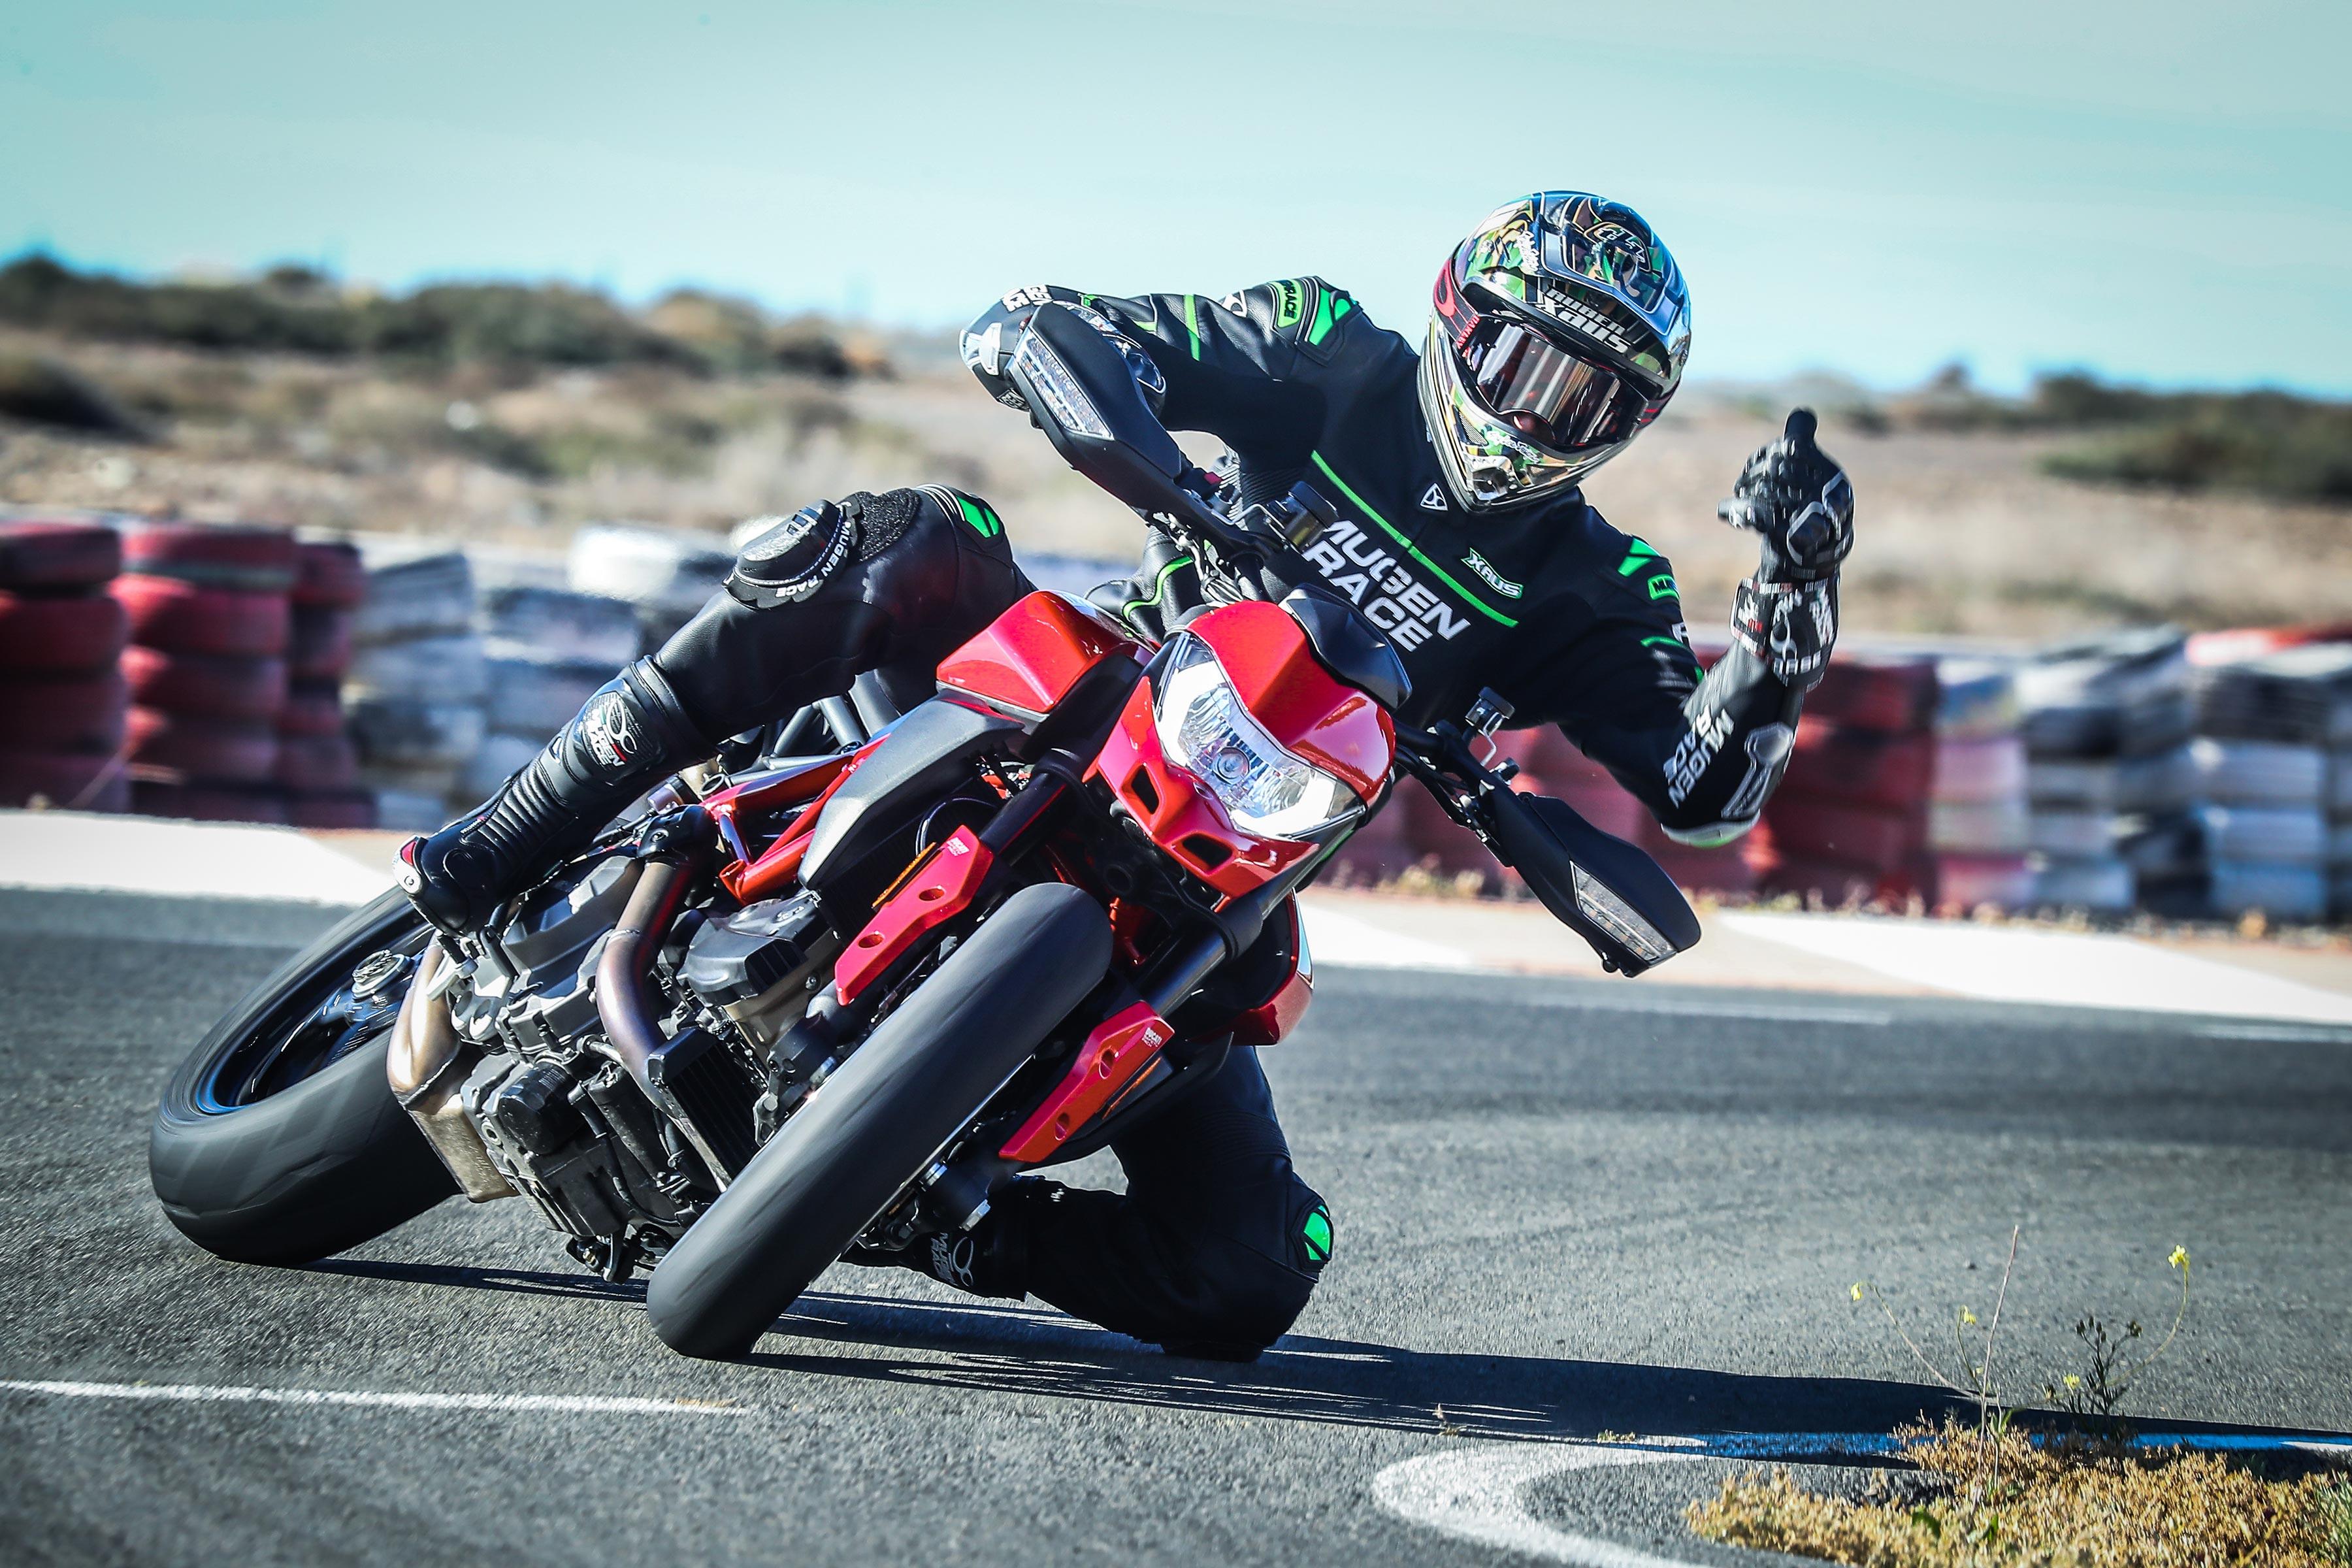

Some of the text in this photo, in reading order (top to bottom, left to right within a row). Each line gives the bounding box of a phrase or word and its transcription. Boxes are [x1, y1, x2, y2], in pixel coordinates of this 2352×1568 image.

[1456, 315, 1480, 350] OAKLEY
[821, 525, 851, 578] MUGEN
[1323, 520, 1471, 640] MUGEN
[1465, 552, 1522, 597] XAUS
[1301, 540, 1433, 653] RACE
[1668, 708, 1734, 809] MUGEN
